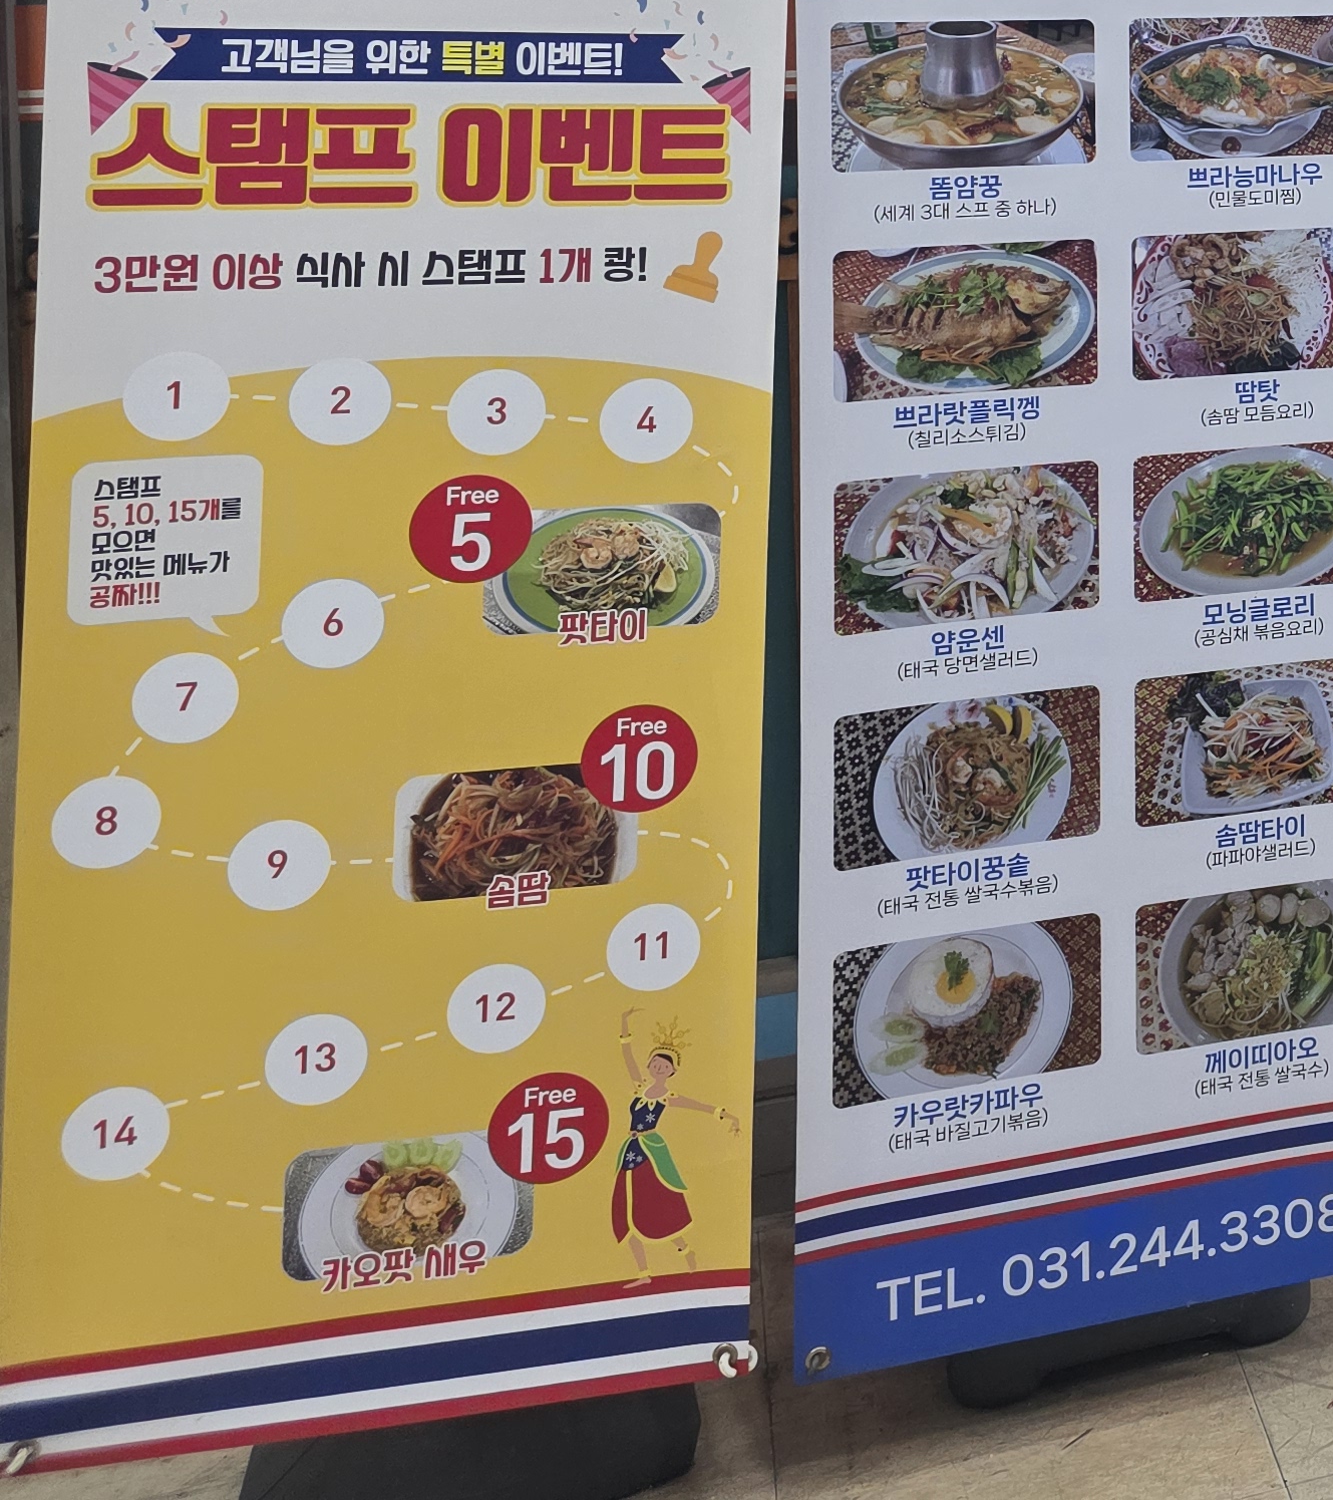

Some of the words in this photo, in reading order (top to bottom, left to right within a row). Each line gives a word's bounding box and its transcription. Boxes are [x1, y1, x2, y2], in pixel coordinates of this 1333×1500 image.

[221, 38, 354, 76] 고객님을
[365, 39, 431, 75] 위한
[441, 41, 505, 76] 특별
[516, 42, 624, 78] 이벤트!
[89, 103, 416, 209] 스탬프
[438, 103, 731, 209] 이벤트
[929, 175, 1003, 200] 똠얌꿍
[1187, 164, 1323, 190] 쁘라능마나우
[873, 203, 917, 225] (세계
[920, 203, 951, 222] 3대
[955, 201, 989, 220] 스프
[994, 200, 1014, 221] 중
[1018, 197, 1057, 219] 하나)
[1208, 188, 1302, 210] (민물도미찜)
[94, 252, 199, 294] 3만원
[212, 252, 283, 291] 이상
[296, 250, 365, 289] 식사
[378, 250, 409, 288] 시
[422, 248, 526, 286] 스탬프
[539, 247, 591, 285] 1개
[604, 246, 648, 282] 쾅!
[166, 381, 182, 411] 1
[329, 386, 351, 414] 2
[486, 397, 507, 426] 3
[636, 405, 658, 434] 4
[1235, 379, 1281, 403] 땀탓
[1201, 405, 1240, 428] (솜땀
[1244, 401, 1315, 425] 모듬요리)
[907, 422, 1027, 450] (칠리소스튀김)
[94, 475, 161, 500] 스탬프
[445, 485, 499, 506] Free
[92, 504, 117, 530] 5,
[123, 502, 158, 530] 10,
[167, 498, 242, 524] 15개를
[91, 529, 156, 555] 모으면
[450, 512, 492, 572] 5
[90, 556, 155, 581] 맛있는
[162, 550, 231, 577] 메뉴가
[89, 582, 161, 610] 공짜!!!
[1203, 595, 1316, 625] 모닝글로리
[558, 609, 648, 646] 팟타이
[931, 625, 1005, 655] 얌운센
[1193, 624, 1249, 649] (공심채
[1253, 618, 1324, 644] 볶음요리)
[897, 657, 940, 682] (태국
[944, 648, 1039, 677] 당면샐러드)
[616, 717, 668, 737] Free
[600, 741, 676, 802] 10
[1215, 814, 1307, 848] 솜땀타이
[1205, 838, 1317, 871] (파파야샐러드)
[906, 852, 1031, 892] 팟타이꿍솥
[486, 871, 550, 911] 솜땀
[877, 890, 920, 919] (태국
[925, 886, 960, 915] 전통
[964, 874, 1059, 905] 쌀국수볶음)
[1203, 1036, 1320, 1074] 께이띠아오
[523, 1086, 576, 1106] Free
[1194, 1072, 1234, 1100] (태국
[1237, 1068, 1270, 1094] 전통
[1274, 1059, 1329, 1088] 쌀국수)
[894, 1082, 1044, 1129] 카우랏카파우
[92, 1115, 138, 1149] 14
[507, 1108, 586, 1175] 15
[887, 1125, 932, 1154] (태국
[936, 1106, 1049, 1147] 바질고기볶음)
[321, 1247, 415, 1294] 카오팟
[425, 1239, 488, 1279] 새우
[877, 1265, 986, 1322] TEL.
